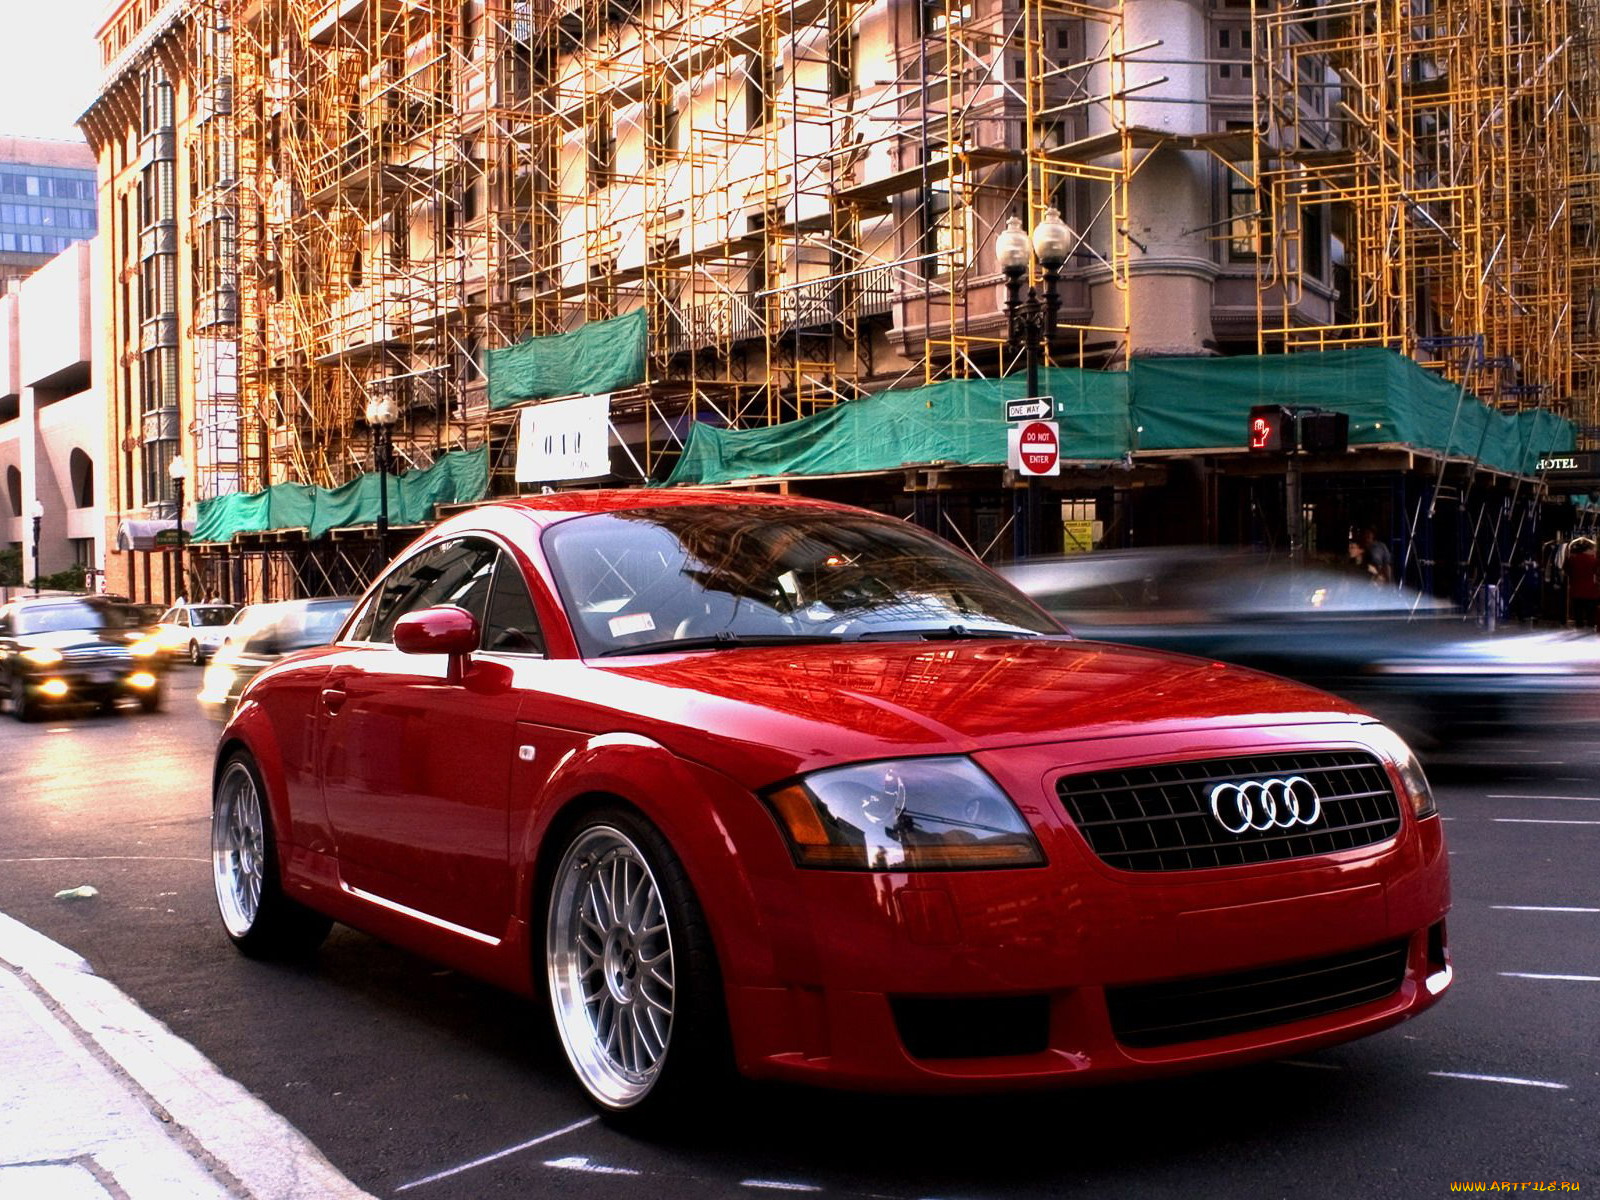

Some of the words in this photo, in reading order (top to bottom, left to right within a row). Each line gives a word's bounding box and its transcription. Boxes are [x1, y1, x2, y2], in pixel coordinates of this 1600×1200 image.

[1011, 407, 1023, 415] ONE
[1026, 405, 1039, 413] WAY
[1027, 433, 1035, 441] DO
[1038, 433, 1049, 441] NOT
[1030, 455, 1049, 463] ENTER
[1535, 458, 1578, 470] HOTEL
